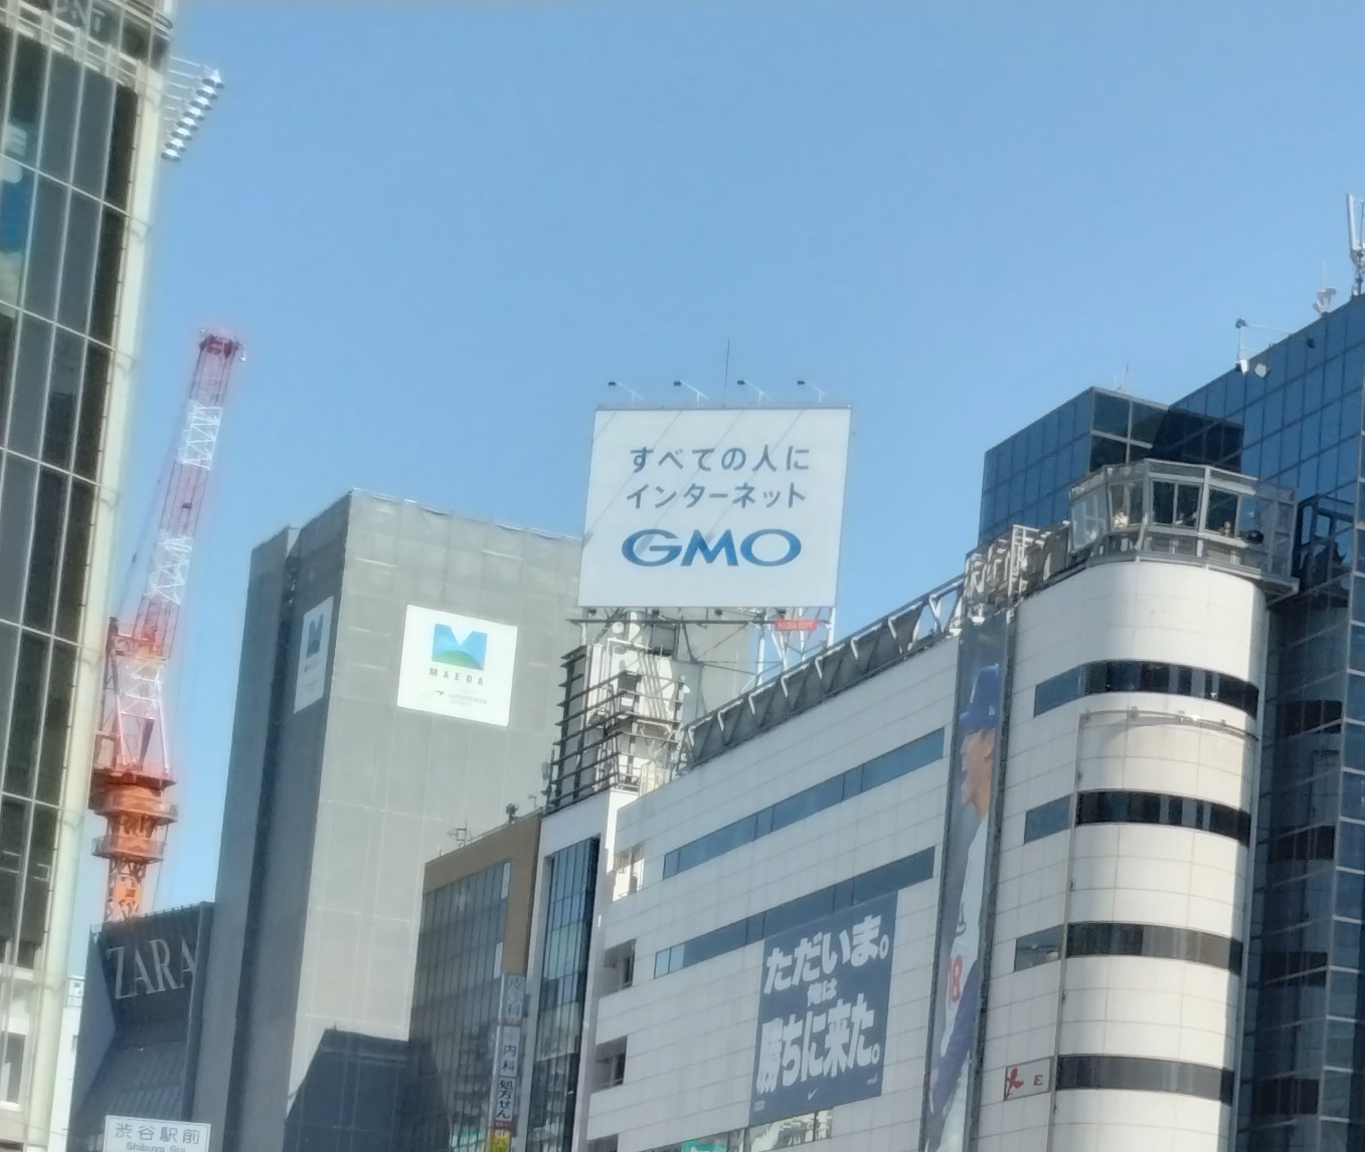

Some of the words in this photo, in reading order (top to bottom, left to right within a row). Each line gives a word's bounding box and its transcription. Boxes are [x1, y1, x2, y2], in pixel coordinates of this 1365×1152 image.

[630, 444, 810, 473] すべての人に
[626, 482, 806, 509] インターネット
[621, 528, 803, 567] GMO
[428, 667, 485, 686] MAEDA
[106, 937, 197, 1000] ZARA
[763, 914, 889, 995] ただいま。
[501, 1044, 517, 1073] 内科
[756, 1003, 882, 1094] 勝ちに来た。
[496, 1079, 514, 1119] 処方せん
[114, 1122, 201, 1145] 渋谷駅前
